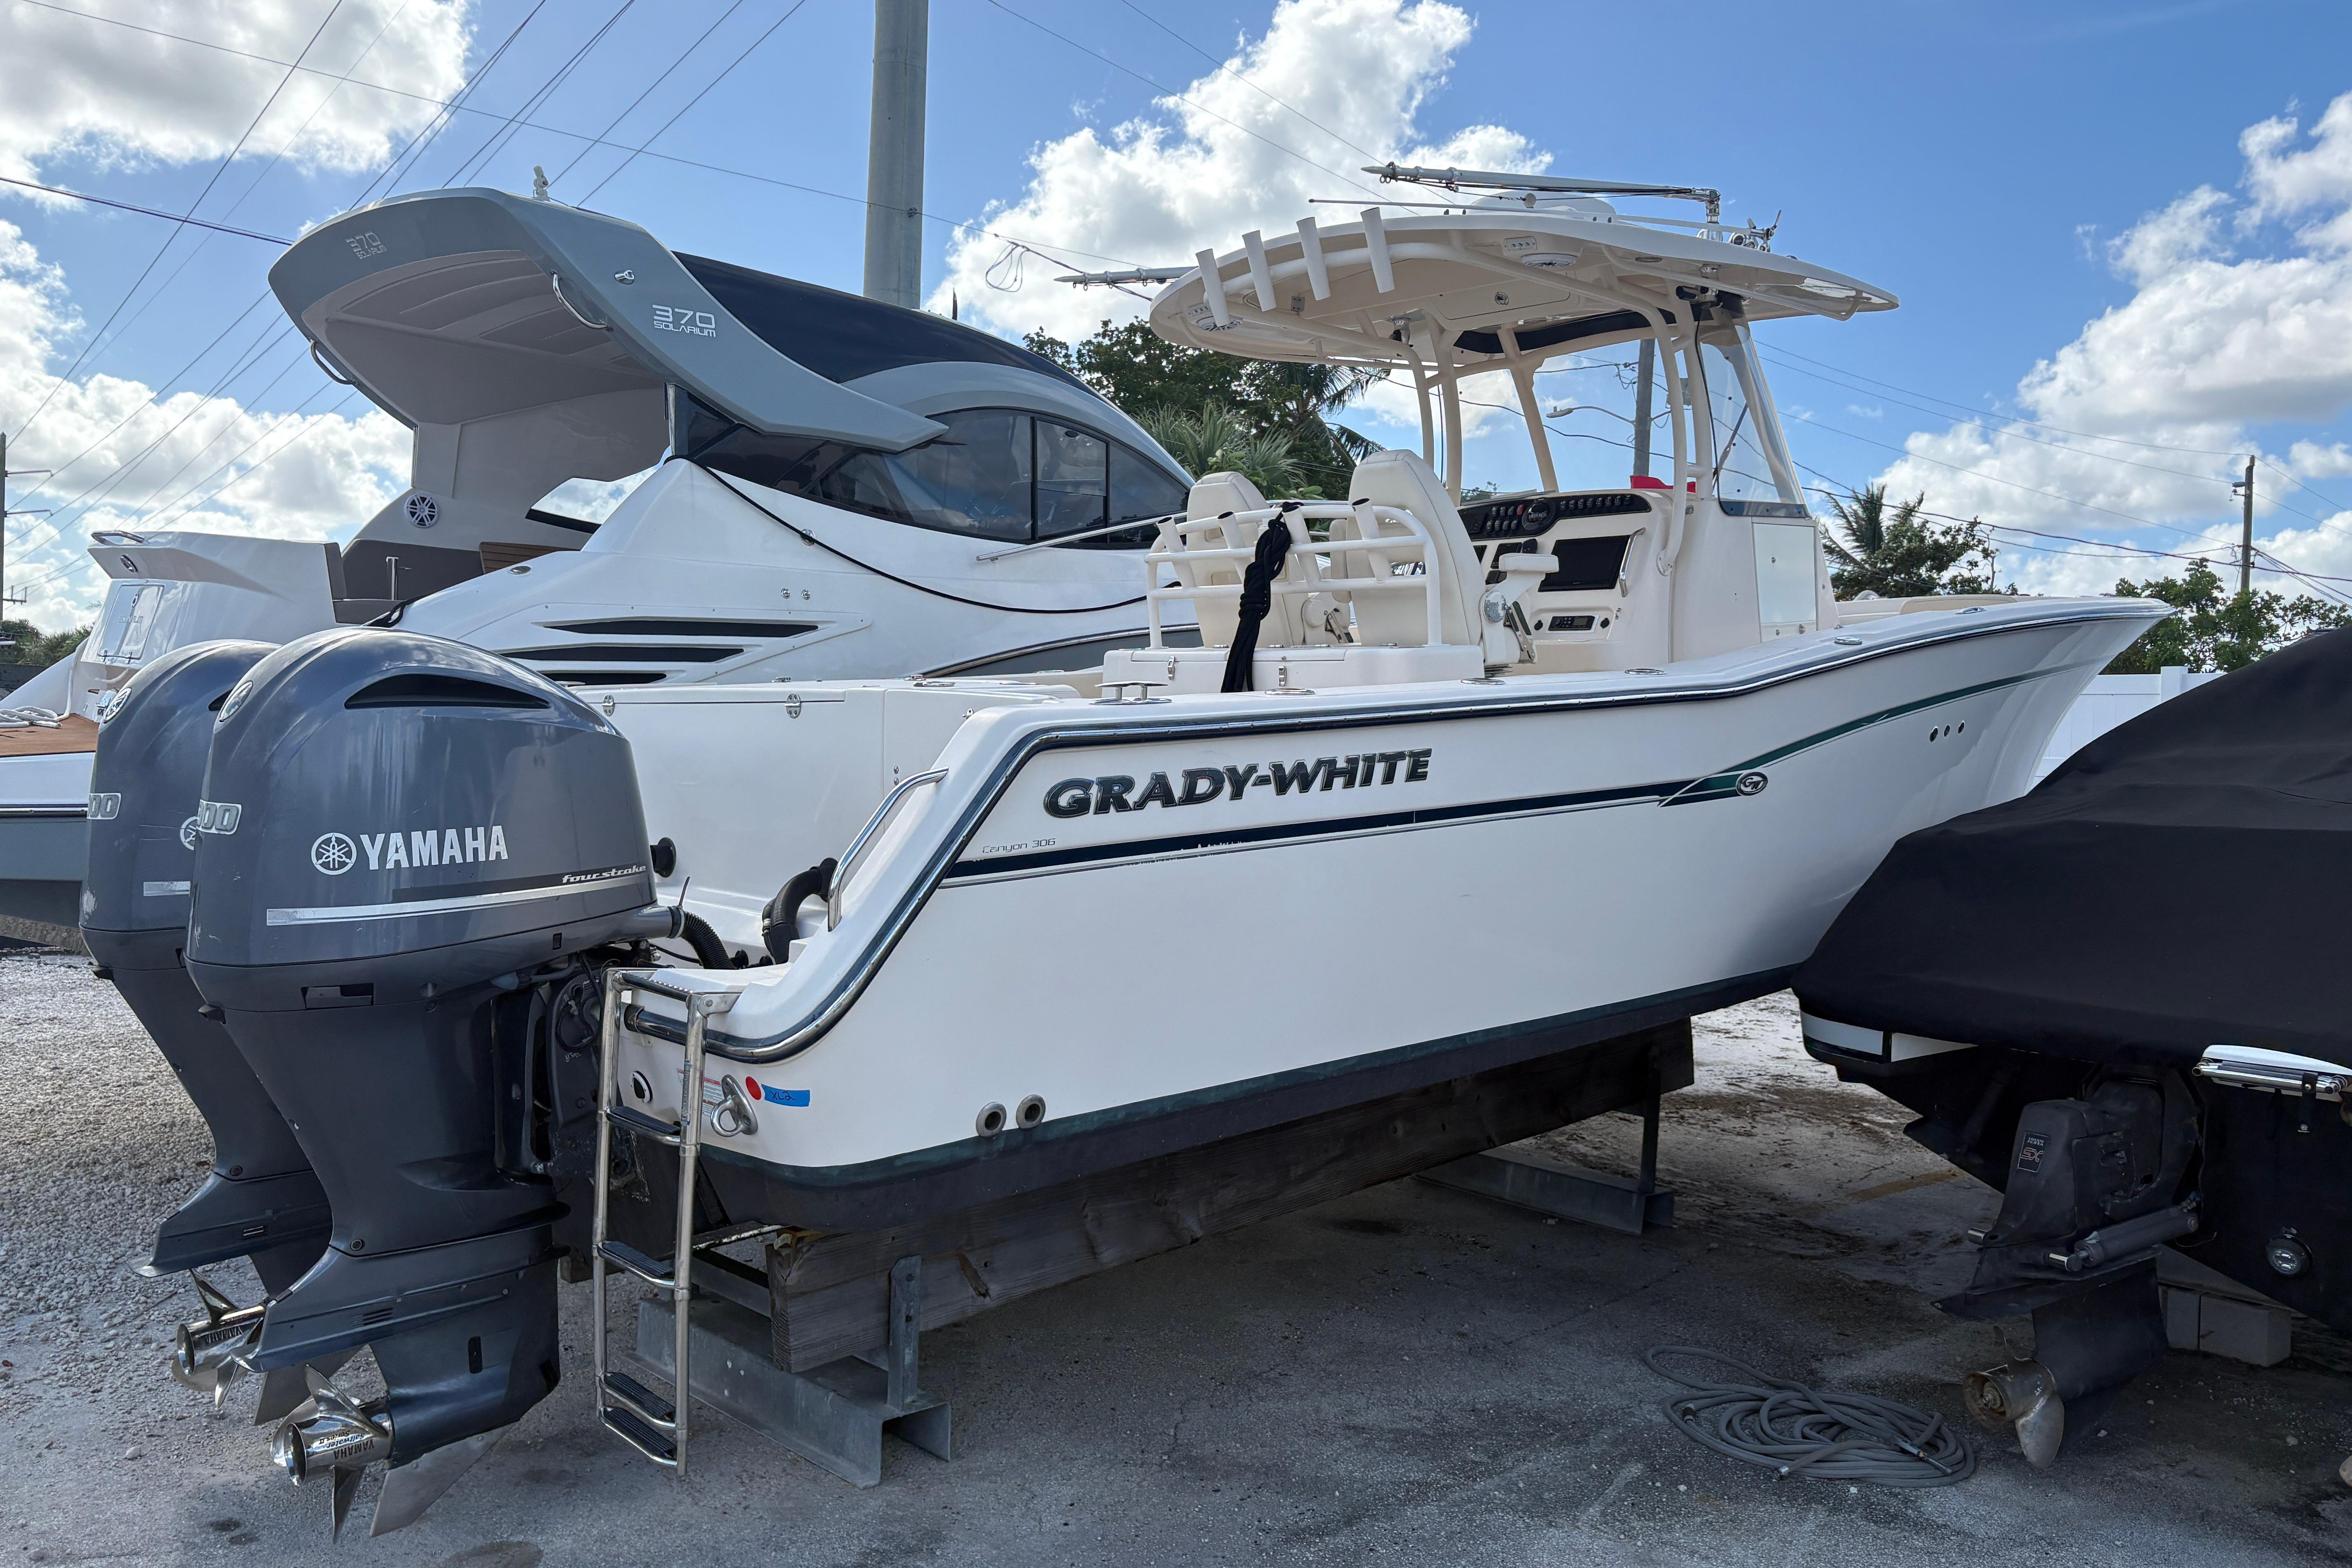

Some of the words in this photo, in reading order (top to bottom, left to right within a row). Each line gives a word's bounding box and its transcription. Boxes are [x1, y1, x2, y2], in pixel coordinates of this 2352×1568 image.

[345, 232, 381, 252] 370
[356, 245, 387, 259] SOLARIUM
[652, 304, 715, 329] 370
[653, 320, 716, 338] SOLARIUM
[1043, 748, 1432, 819] GRADY-WHITE
[359, 825, 508, 870] YAMAHA
[982, 843, 1027, 853] Canyon
[1032, 838, 1056, 848] 306
[770, 1090, 796, 1101] XL2
[206, 1326, 244, 1344] YAMAHA
[327, 1430, 350, 1442] Series
[327, 1433, 365, 1448] Saltwater
[334, 1439, 374, 1460] YAMAHA
